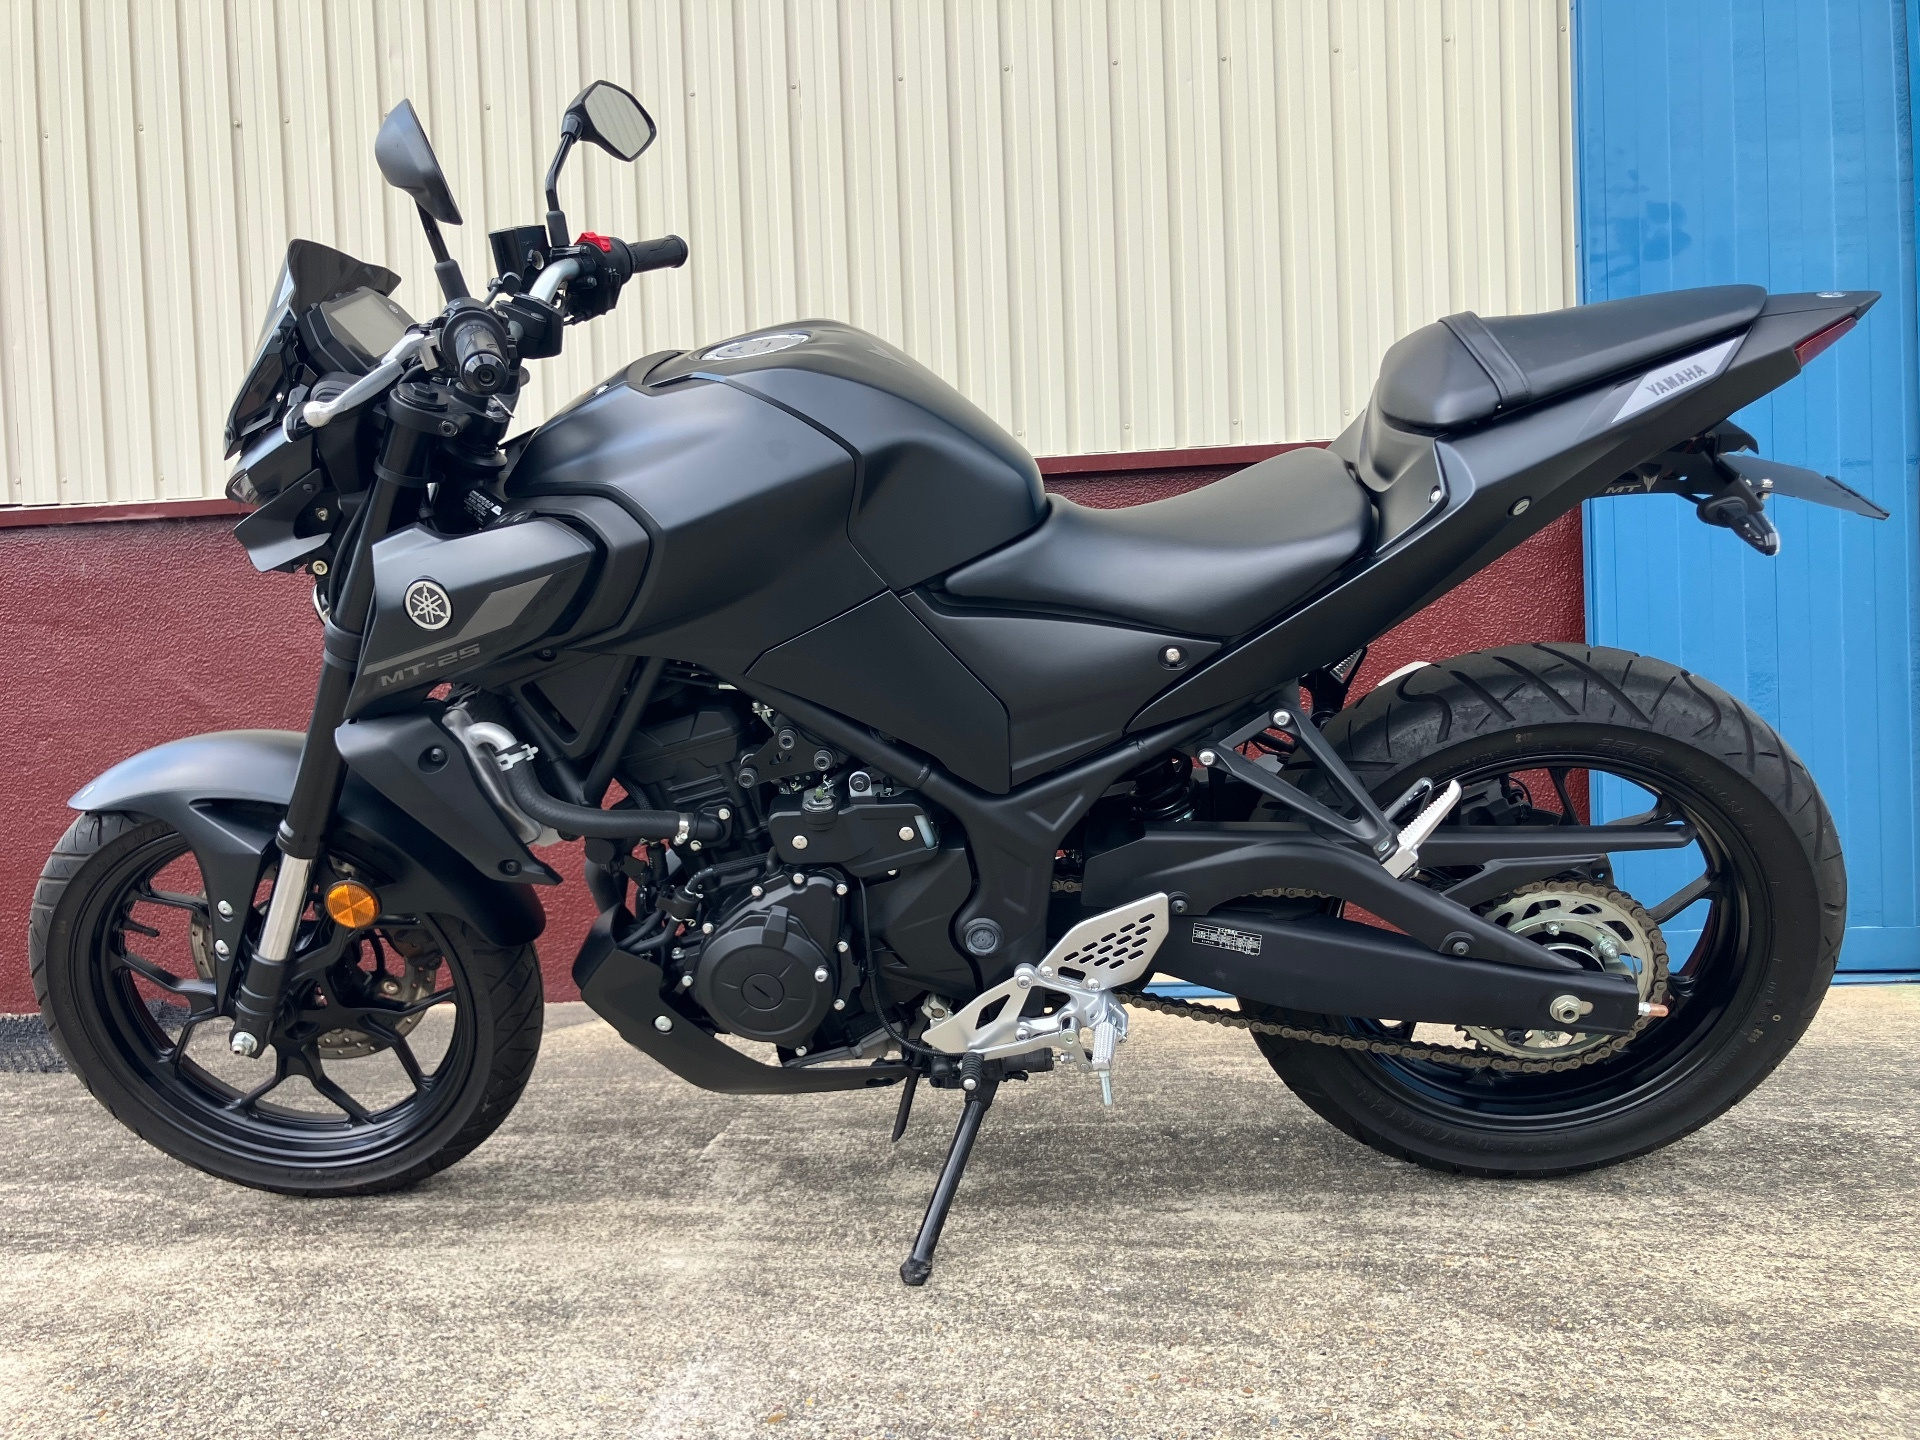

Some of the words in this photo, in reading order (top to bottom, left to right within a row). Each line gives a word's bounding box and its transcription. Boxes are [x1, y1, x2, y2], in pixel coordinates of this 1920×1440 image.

[1646, 364, 1707, 396] YAMAHA
[1605, 484, 1641, 494] MT
[381, 643, 480, 687] MT-25
